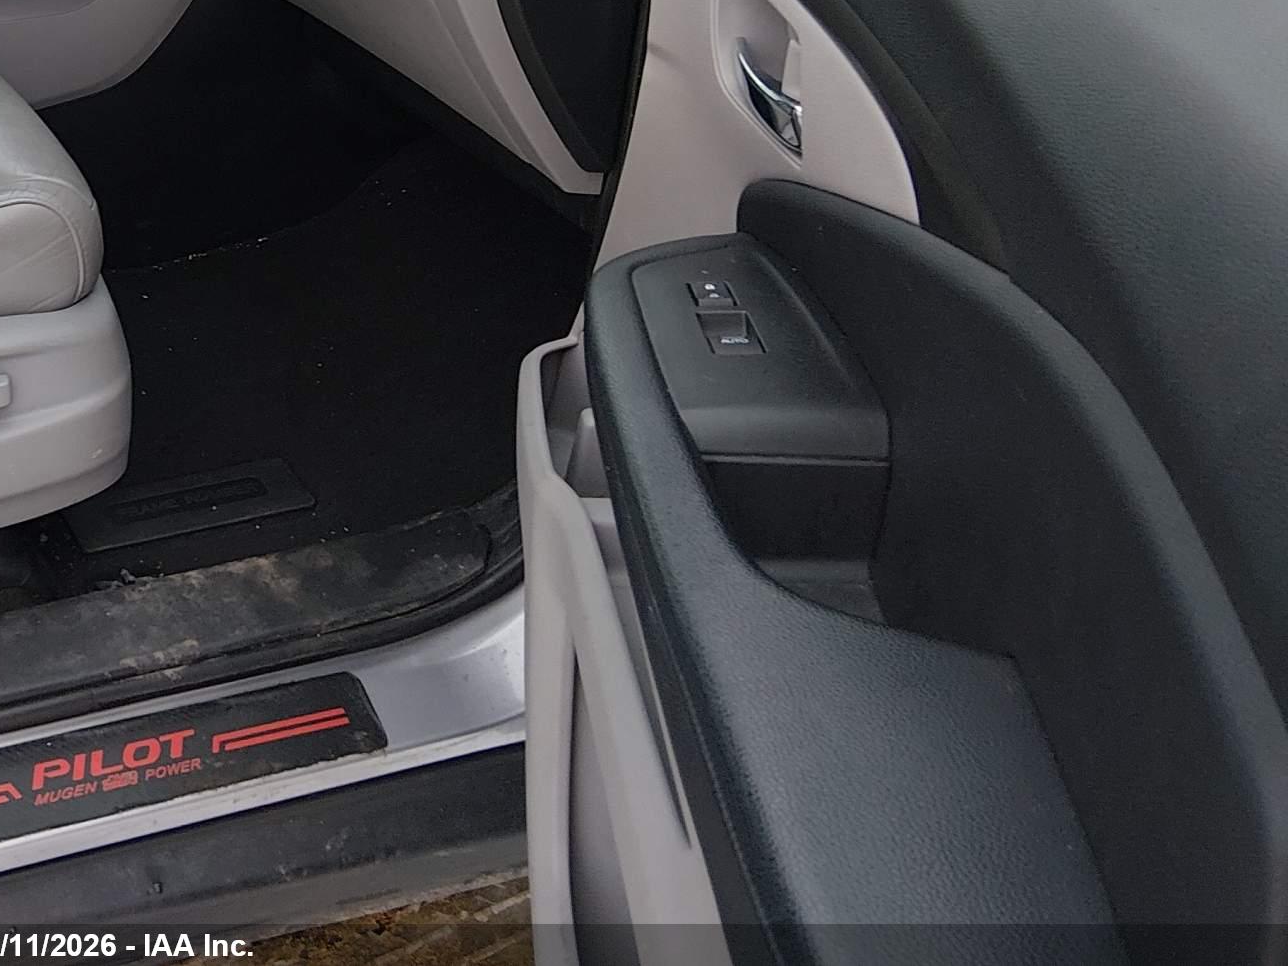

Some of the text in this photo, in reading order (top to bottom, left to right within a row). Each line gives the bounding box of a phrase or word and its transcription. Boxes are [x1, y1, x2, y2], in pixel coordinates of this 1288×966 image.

[32, 729, 194, 790] PILOT
[34, 781, 97, 806] MUGEN
[145, 757, 202, 781] POWER
